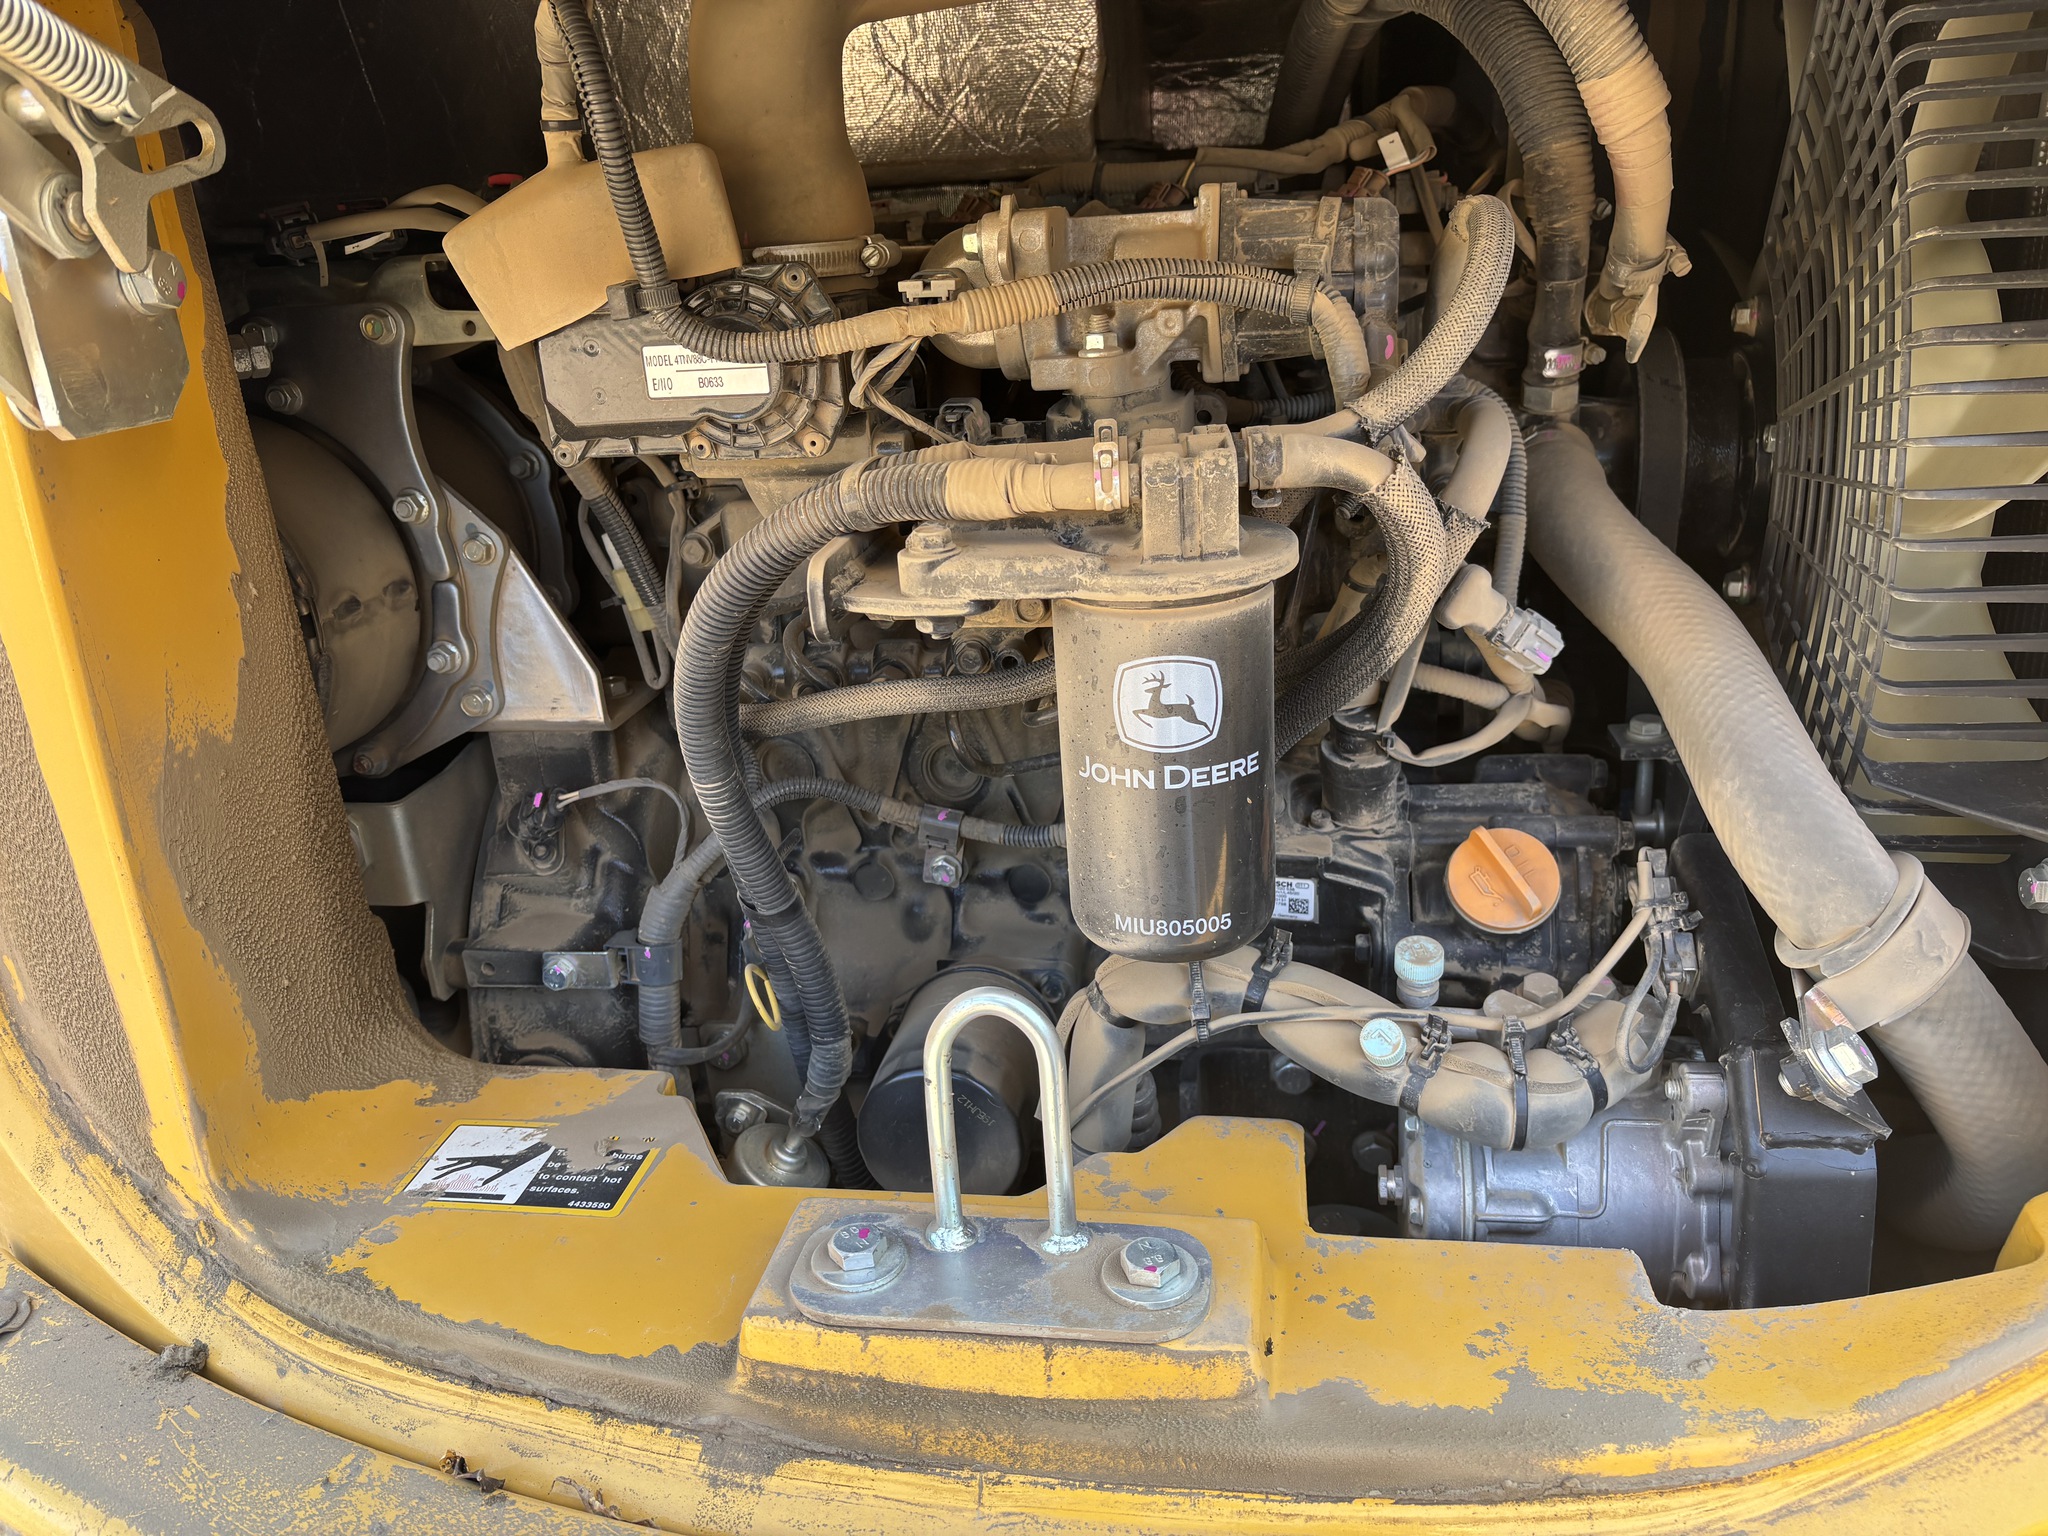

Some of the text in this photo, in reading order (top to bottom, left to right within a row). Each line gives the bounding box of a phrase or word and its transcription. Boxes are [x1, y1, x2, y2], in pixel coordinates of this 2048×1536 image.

[645, 354, 719, 367] MODEL 4TNV88C-
[698, 376, 725, 389] B0633
[1078, 750, 1260, 790] JOHN DEERE
[1275, 880, 1293, 888] SCH
[1114, 912, 1232, 936] MIU805005
[547, 1160, 562, 1168] be
[555, 1175, 598, 1183] contact
[602, 1176, 622, 1184] hot
[529, 1185, 580, 1195] surfaces.
